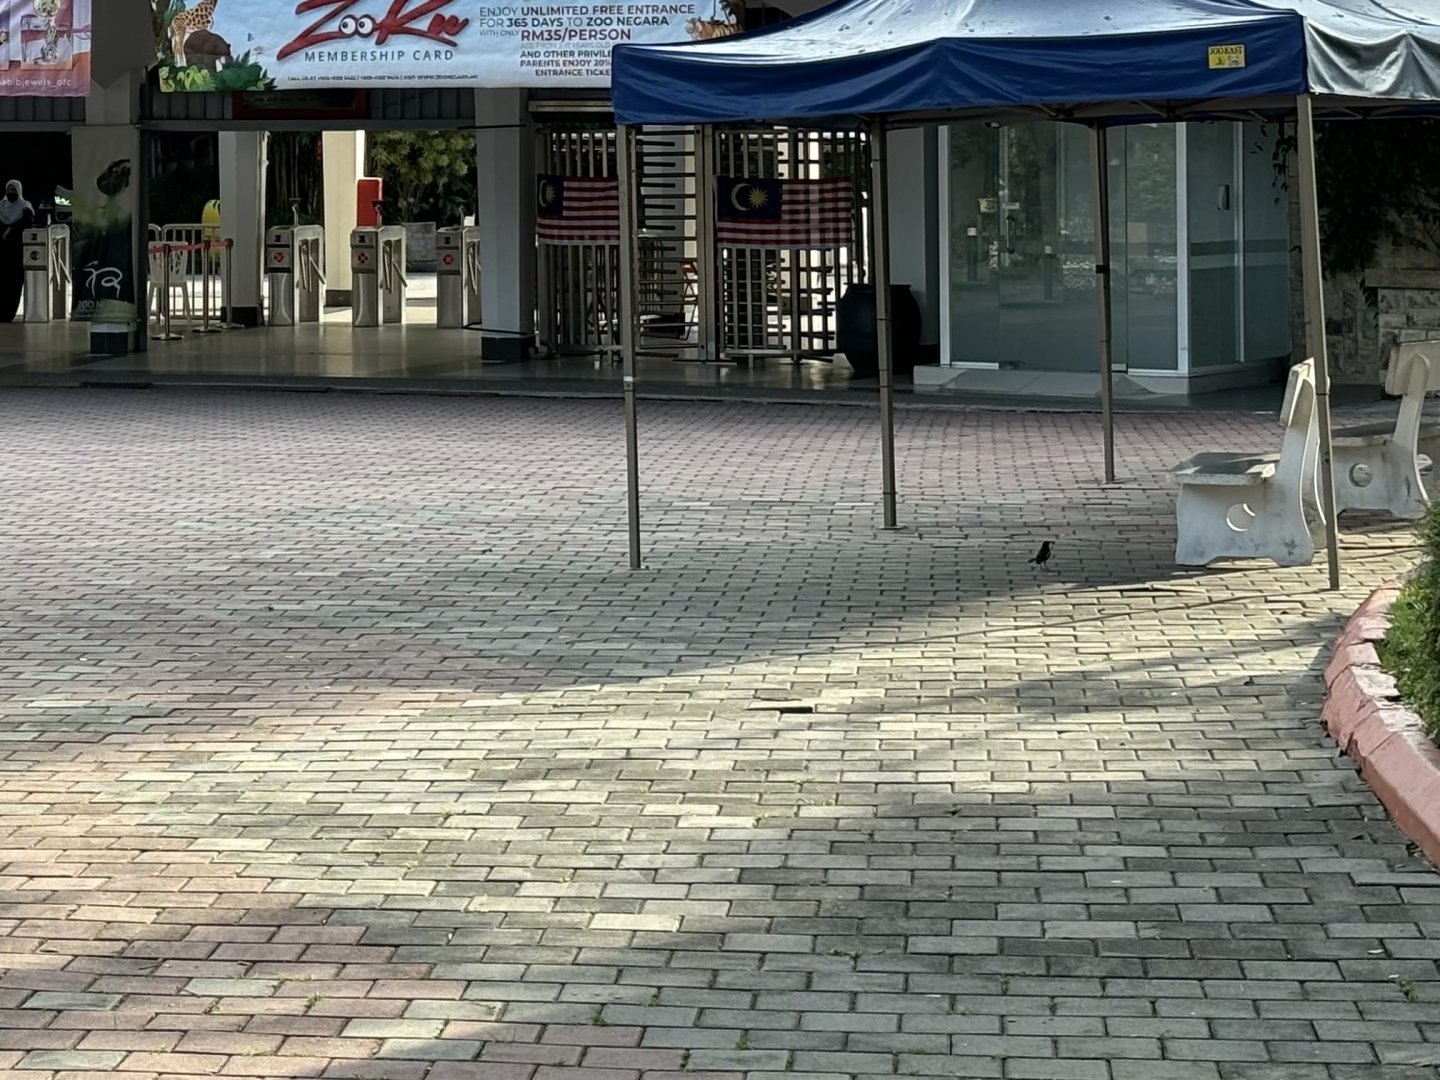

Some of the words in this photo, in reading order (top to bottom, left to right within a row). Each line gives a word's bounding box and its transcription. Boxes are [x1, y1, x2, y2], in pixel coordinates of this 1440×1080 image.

[479, 6, 519, 17] ENJOY
[521, 5, 589, 16] UNLIMITED
[592, 4, 624, 15] FREE
[627, 4, 695, 15] ENTRANCE
[479, 18, 505, 28] FOR
[506, 17, 528, 27] 365
[531, 17, 564, 27] DAYS
[567, 17, 583, 27] TO
[586, 16, 613, 27] ZOO
[616, 15, 669, 26] NEGARA
[479, 29, 499, 37] WITH
[500, 29, 520, 37] ONLY
[521, 28, 632, 43] RM35/PERSON
[304, 50, 405, 62] MEMBERSHIP
[413, 49, 454, 61] CARD
[520, 50, 541, 59] AND
[543, 50, 575, 58] OTHER
[520, 59, 561, 68] PARENTS
[562, 59, 592, 68] ENJOY
[535, 68, 583, 77] ENTRANCE
[585, 68, 611, 77] TICKE
